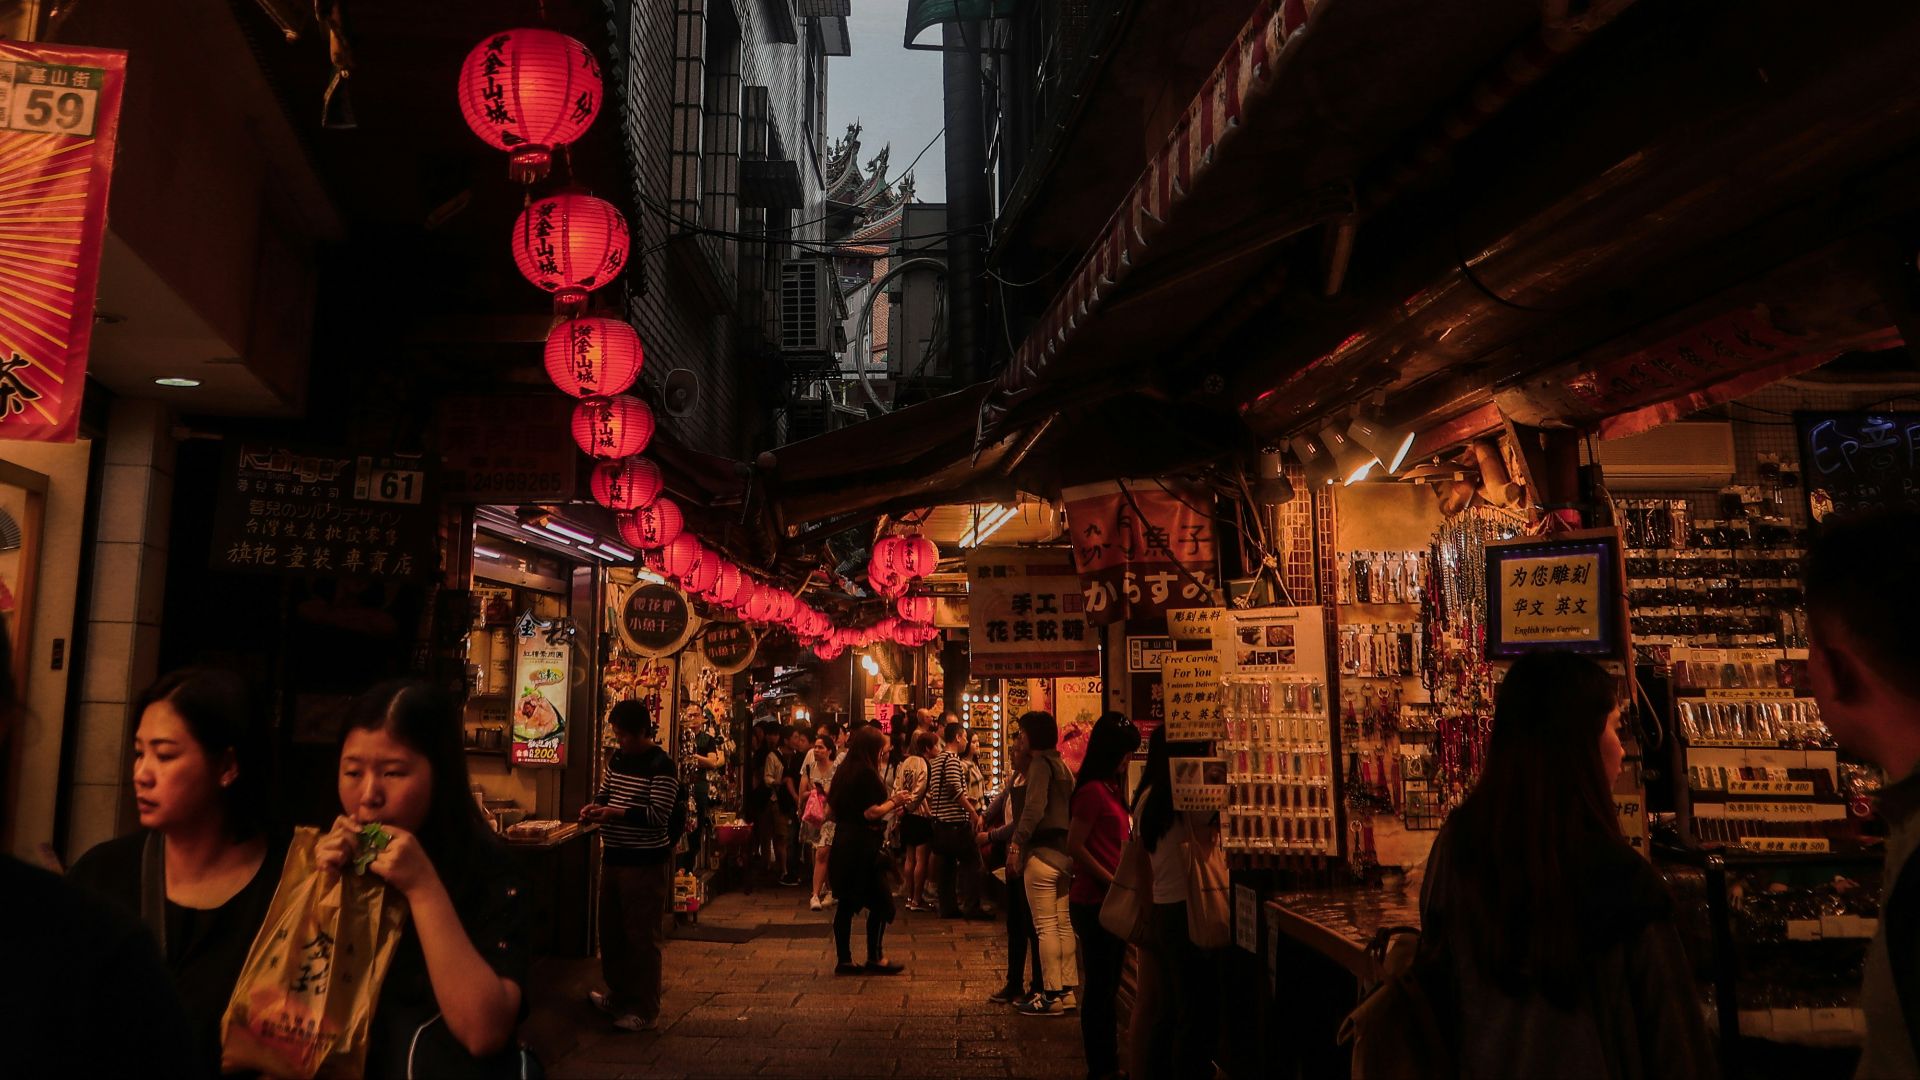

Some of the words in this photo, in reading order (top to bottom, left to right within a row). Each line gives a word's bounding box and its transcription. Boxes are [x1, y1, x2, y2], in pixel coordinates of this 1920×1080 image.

[29, 67, 91, 88] 基山街
[24, 89, 84, 129] 59
[598, 404, 617, 449] 金山城
[381, 472, 414, 499] 61
[1510, 563, 1591, 587] 为您雕刻
[1084, 571, 1215, 613] からすみ
[1513, 598, 1544, 617] 华文
[1555, 597, 1587, 616] 英文
[1165, 656, 1184, 664] Free
[1186, 654, 1218, 664] Carving
[1173, 668, 1191, 678] For
[1194, 668, 1212, 678] You
[1008, 688, 1027, 698] 1999
[1171, 709, 1191, 721] 中文
